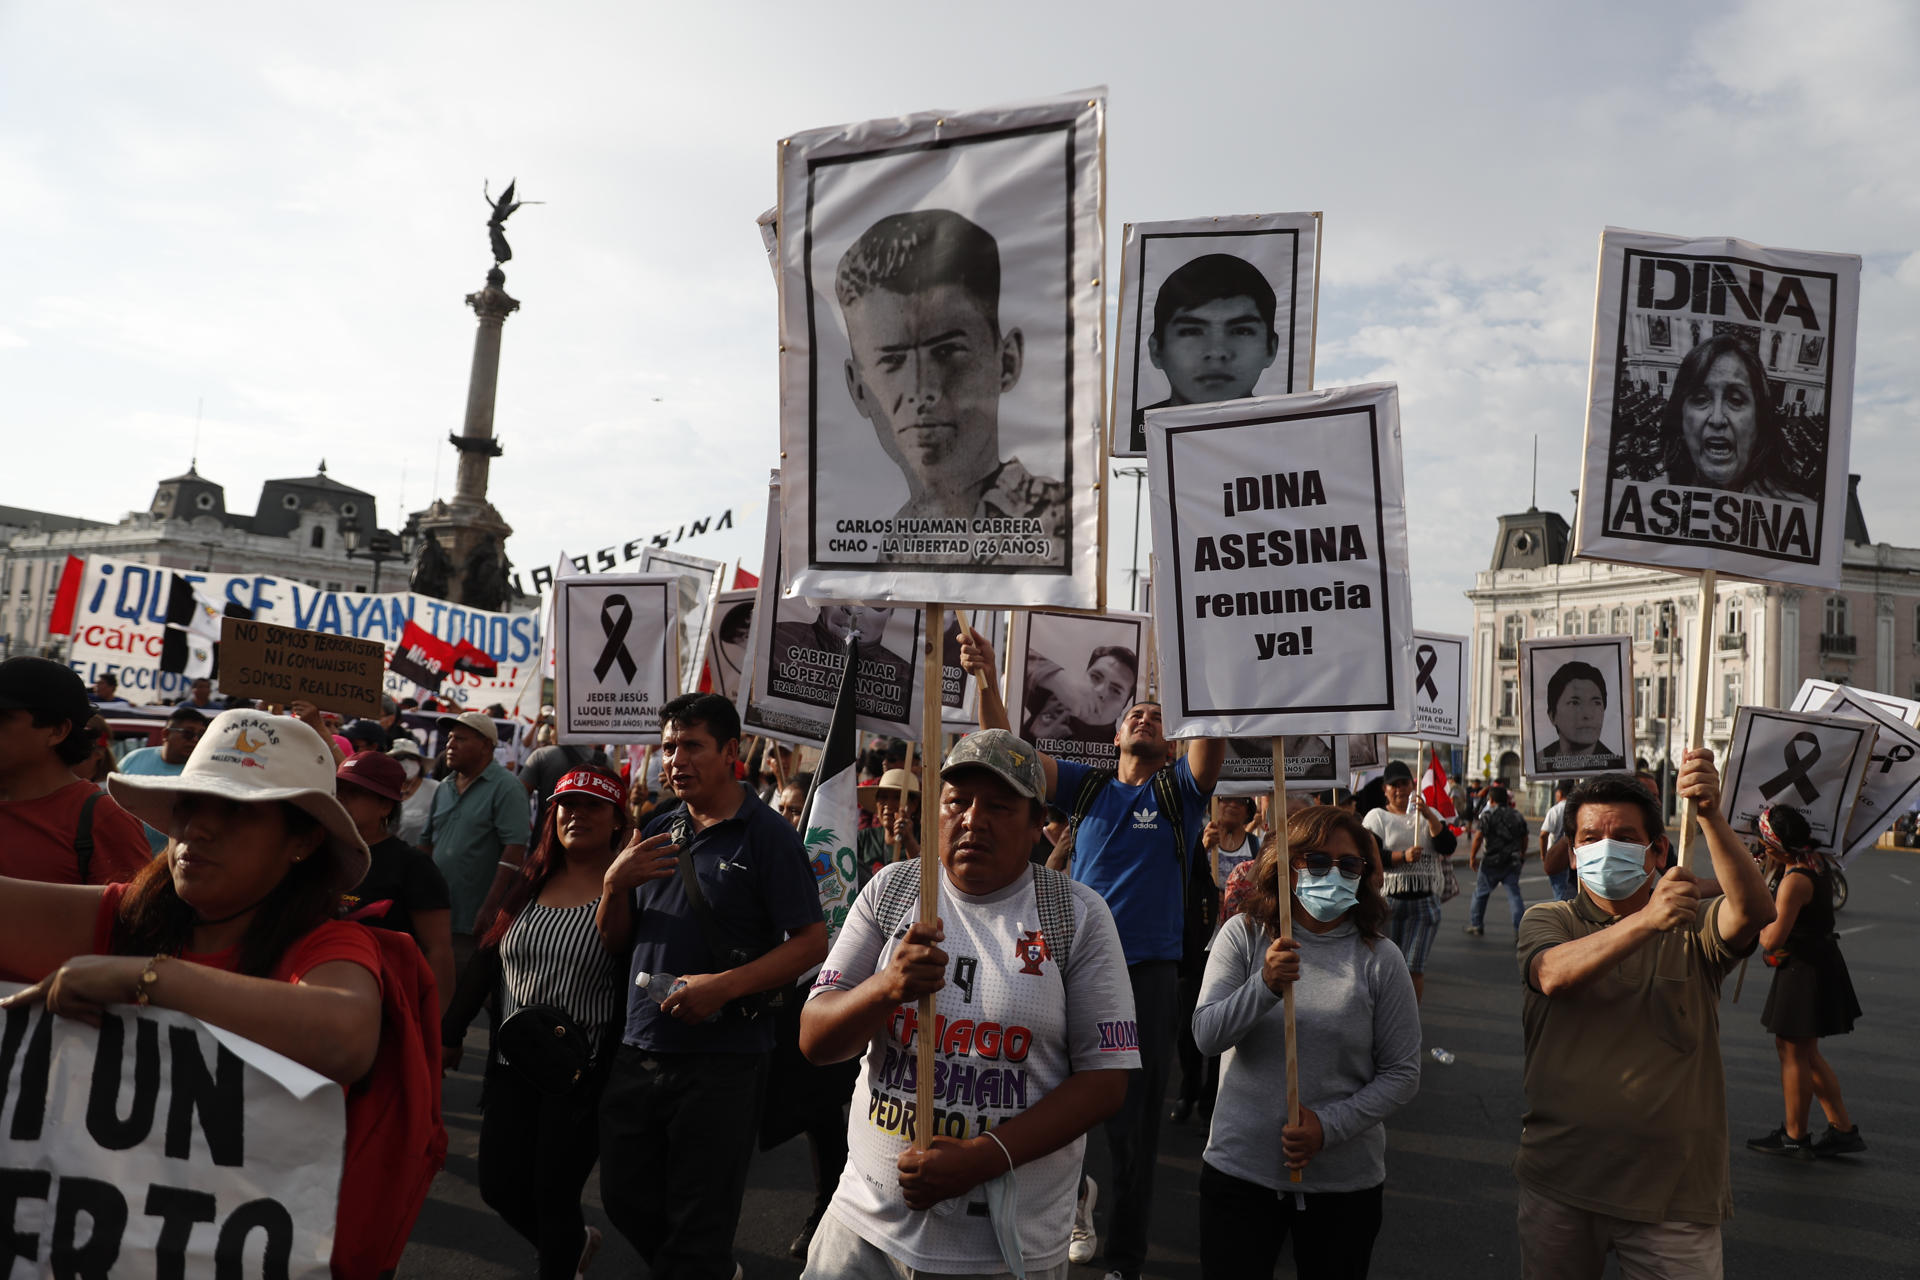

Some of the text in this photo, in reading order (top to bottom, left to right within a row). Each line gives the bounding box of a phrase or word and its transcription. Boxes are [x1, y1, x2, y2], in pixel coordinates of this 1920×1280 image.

[1637, 258, 1821, 331] DINA
[1223, 470, 1327, 517] ¡DINA
[836, 518, 1043, 535] CARLOS HUAMAN CABRERA
[1612, 484, 1812, 557] ASESINA
[829, 538, 868, 552] CHAO
[882, 540, 899, 553] LA
[903, 540, 969, 554] LIBERTAD
[973, 540, 996, 559] (26
[999, 536, 1051, 557] AÑOS)
[1194, 524, 1368, 572] ASESINA
[89, 564, 206, 625] ¡QU
[292, 586, 415, 642] VAYAN
[428, 602, 540, 663] TODOS!
[1195, 580, 1371, 618] renuncia
[234, 624, 383, 658] NO SOMOS TERRORISTAS
[788, 646, 846, 669] GABRIEL
[1255, 626, 1313, 661] ya!
[265, 648, 284, 666] NI
[287, 654, 366, 676] COMUNISTAS
[780, 661, 825, 685] LÓPEZ
[239, 667, 375, 703] SOMOS REALISTAS
[586, 690, 649, 702] JEDER JESÚS
[773, 680, 829, 702] TRABAJADOR
[877, 699, 904, 717] PUNO
[573, 719, 609, 727] CAMPESINO
[577, 707, 657, 717] LUQUE MAMANI
[1037, 738, 1116, 757] NELSON UBER
[592, 777, 621, 800] Perú
[888, 1006, 1033, 1062] THIAGO
[86, 1008, 244, 1167] UN
[869, 1088, 968, 1142] PEDRTO
